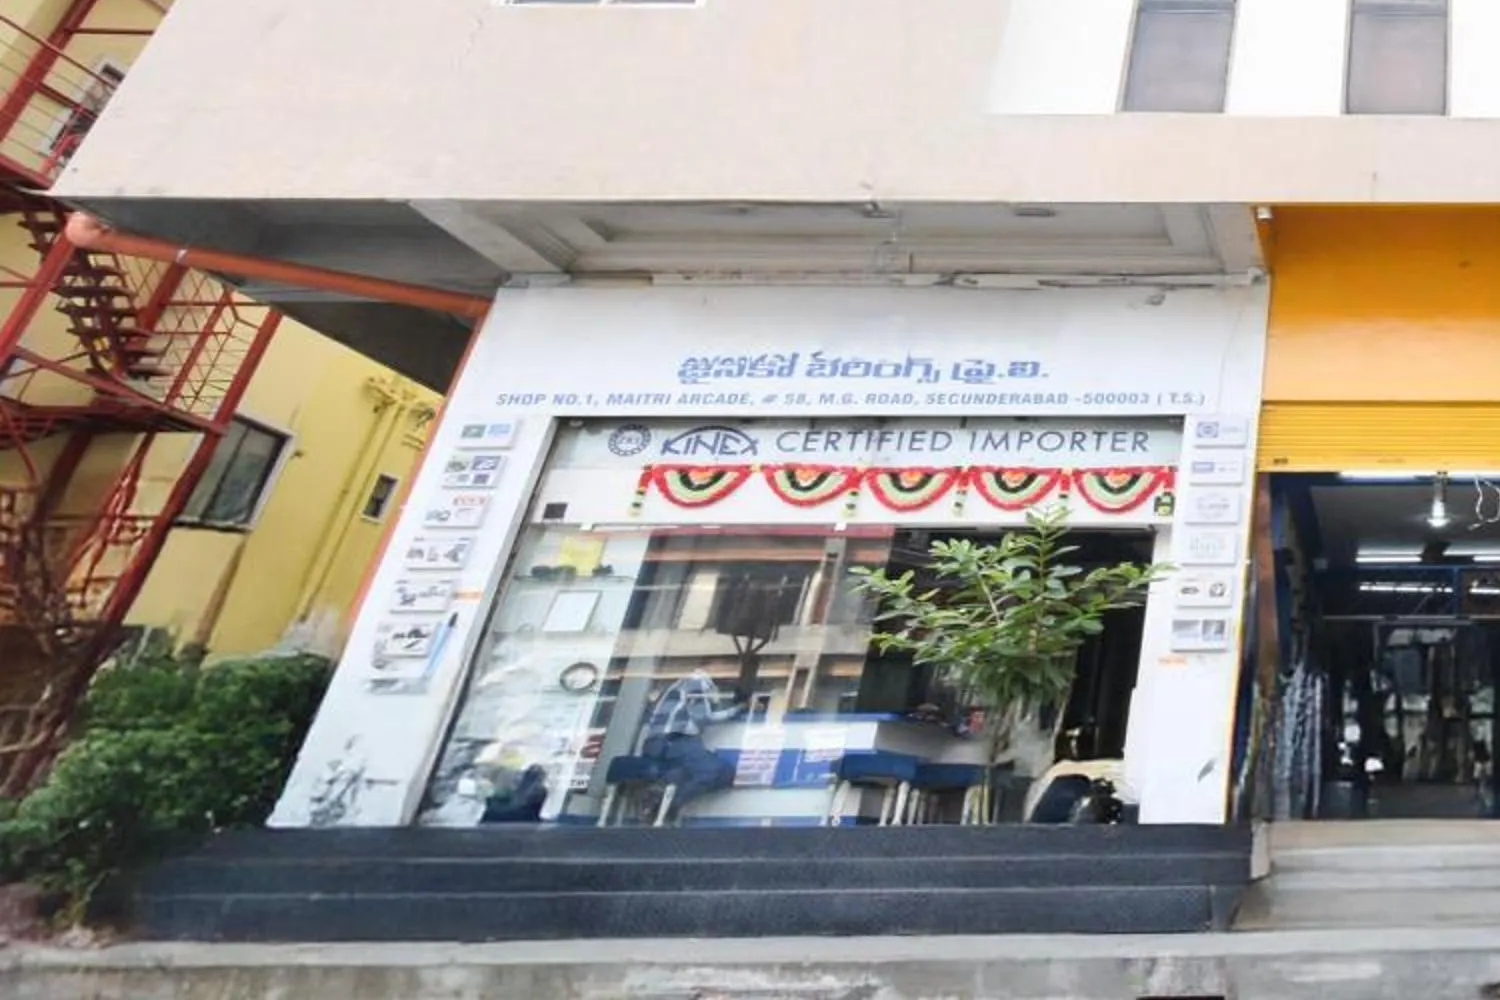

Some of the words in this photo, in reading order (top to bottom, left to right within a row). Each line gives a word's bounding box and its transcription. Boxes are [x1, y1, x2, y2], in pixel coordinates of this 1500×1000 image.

[496, 392, 546, 406] SHOP
[606, 392, 671, 406] MAITRI
[926, 392, 1069, 406] SECUNDERABAD
[660, 424, 760, 456] KINEX
[777, 430, 952, 453] CERTIFIED
[969, 430, 1150, 453] IMPORTER
